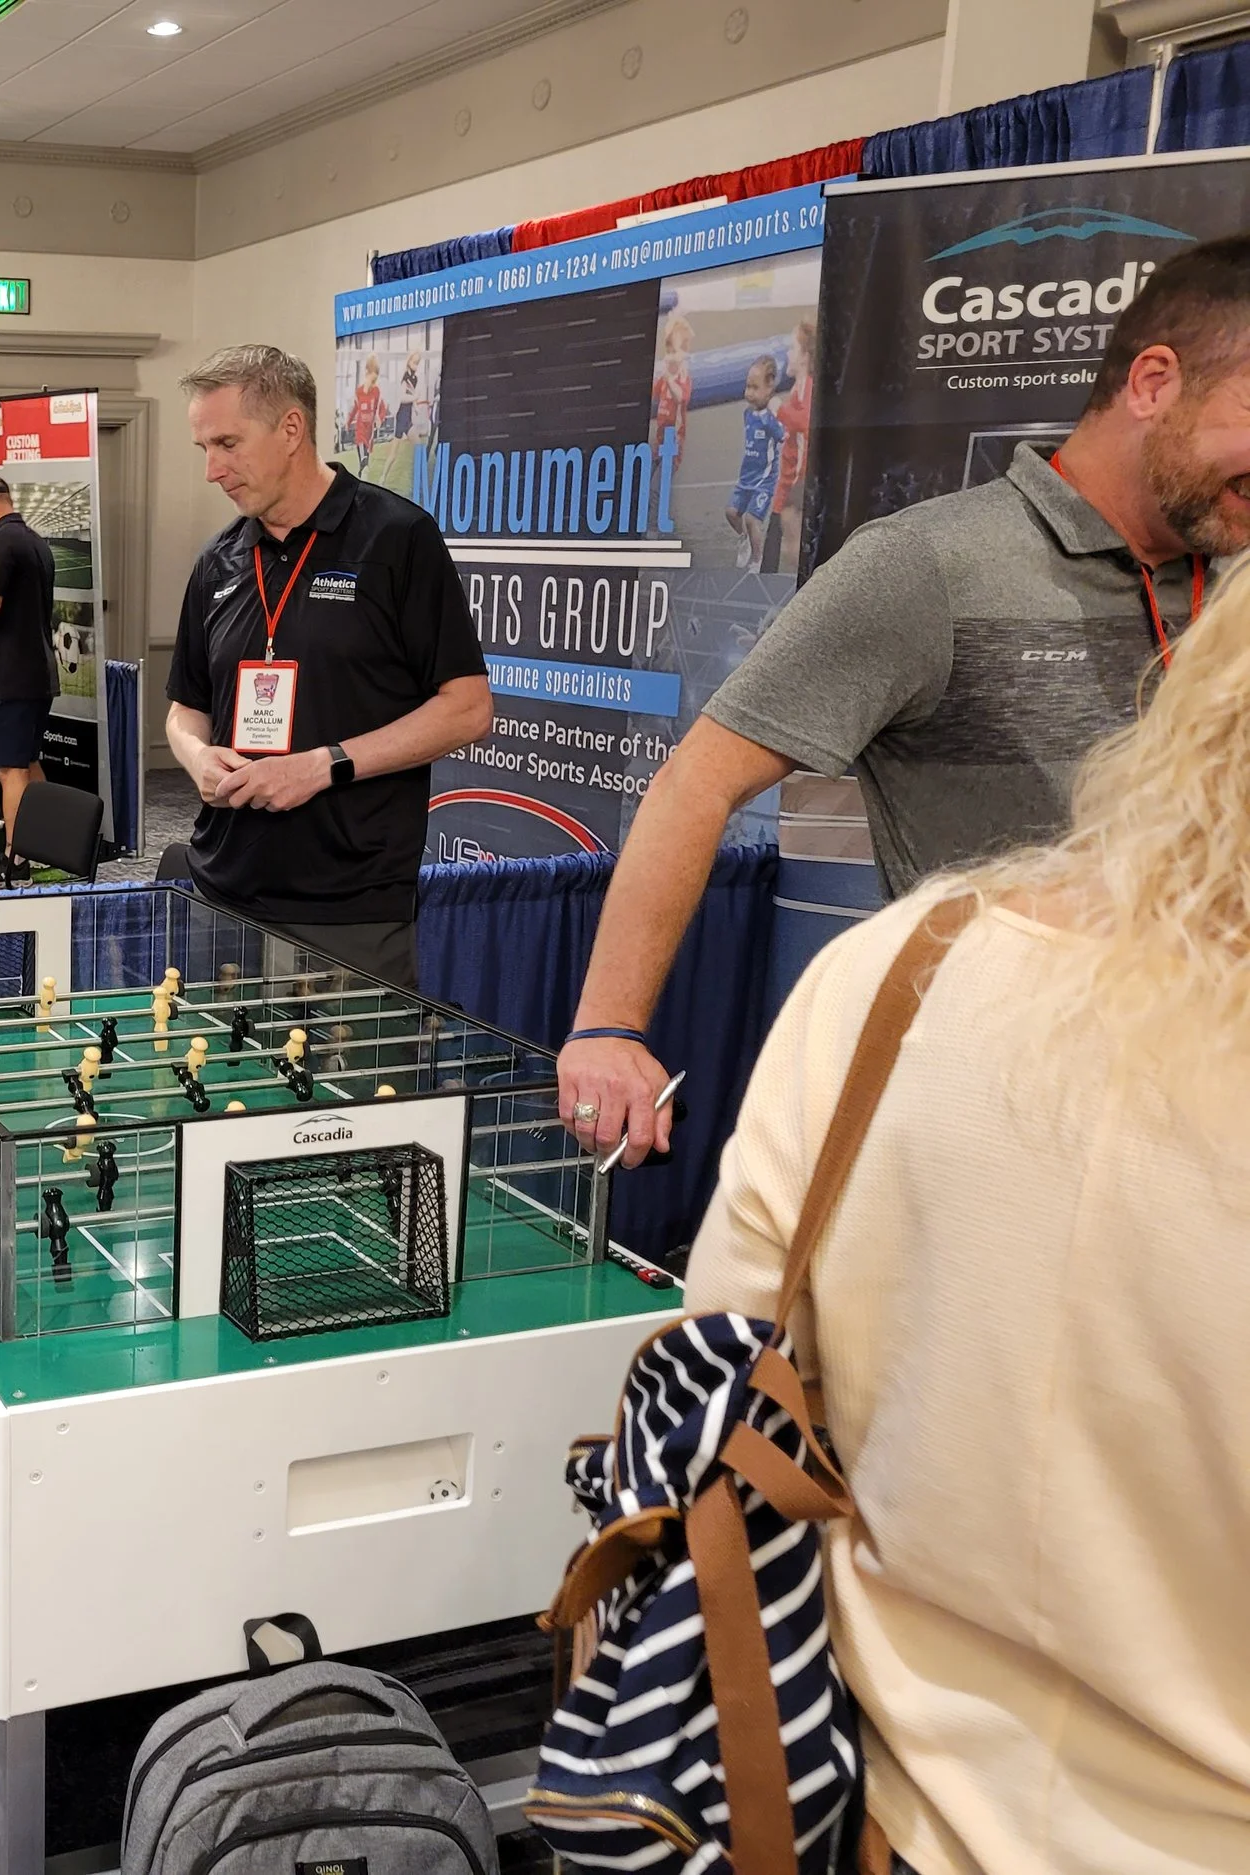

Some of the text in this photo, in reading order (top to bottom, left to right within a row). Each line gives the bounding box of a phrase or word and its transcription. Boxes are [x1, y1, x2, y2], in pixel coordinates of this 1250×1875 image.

[342, 204, 826, 322] www.monumentsports.com (866) 674-1234 msg@monumentsports.co
[922, 261, 1156, 324] Cascadi
[917, 324, 1114, 360] SPORT SYST
[948, 368, 1098, 391] Custom sport solu
[6, 434, 40, 449] CUSTOM
[413, 426, 679, 534] Monument
[312, 576, 356, 589] Athletica
[468, 573, 669, 658] RTS GROUP
[1020, 650, 1087, 662] CCM
[546, 669, 632, 702] specialists
[243, 717, 283, 725] MCCALLUM
[253, 709, 274, 717] MARC
[492, 714, 540, 741] rance
[545, 720, 615, 753] Partner
[620, 736, 641, 757] of
[470, 744, 523, 771] Indoor
[527, 752, 585, 784] Sports
[588, 763, 654, 796] Associ
[293, 1127, 353, 1144] Cascadia
